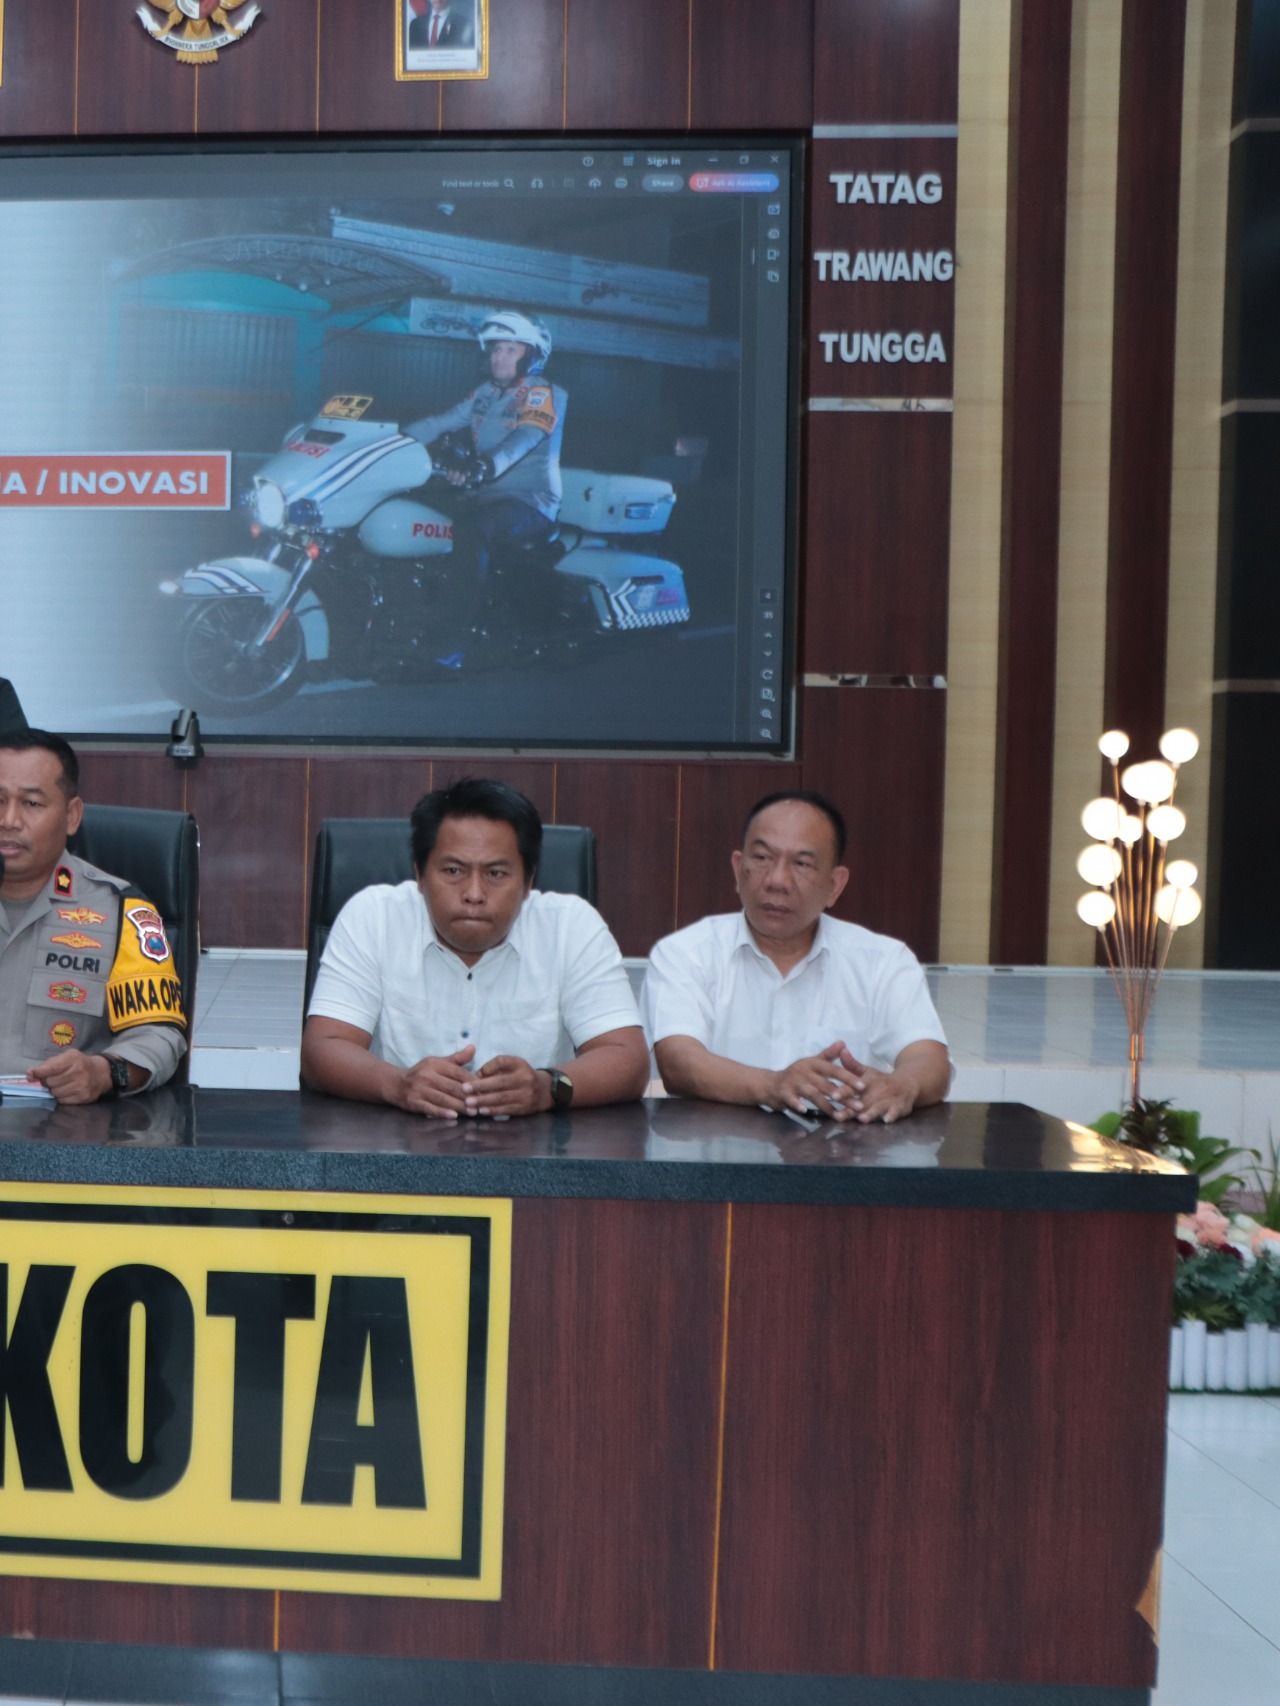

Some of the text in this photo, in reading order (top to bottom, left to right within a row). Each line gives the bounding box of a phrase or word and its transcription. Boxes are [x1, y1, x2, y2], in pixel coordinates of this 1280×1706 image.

[647, 157, 681, 167] Sign in
[442, 180, 458, 188] Find
[829, 173, 943, 204] TATAG
[814, 251, 954, 282] TRAWANG
[819, 332, 947, 363] TUNGGA
[35, 470, 47, 496] /
[60, 470, 208, 495] INOVASI
[45, 953, 100, 973] POLRI
[109, 979, 160, 1019] WAKA
